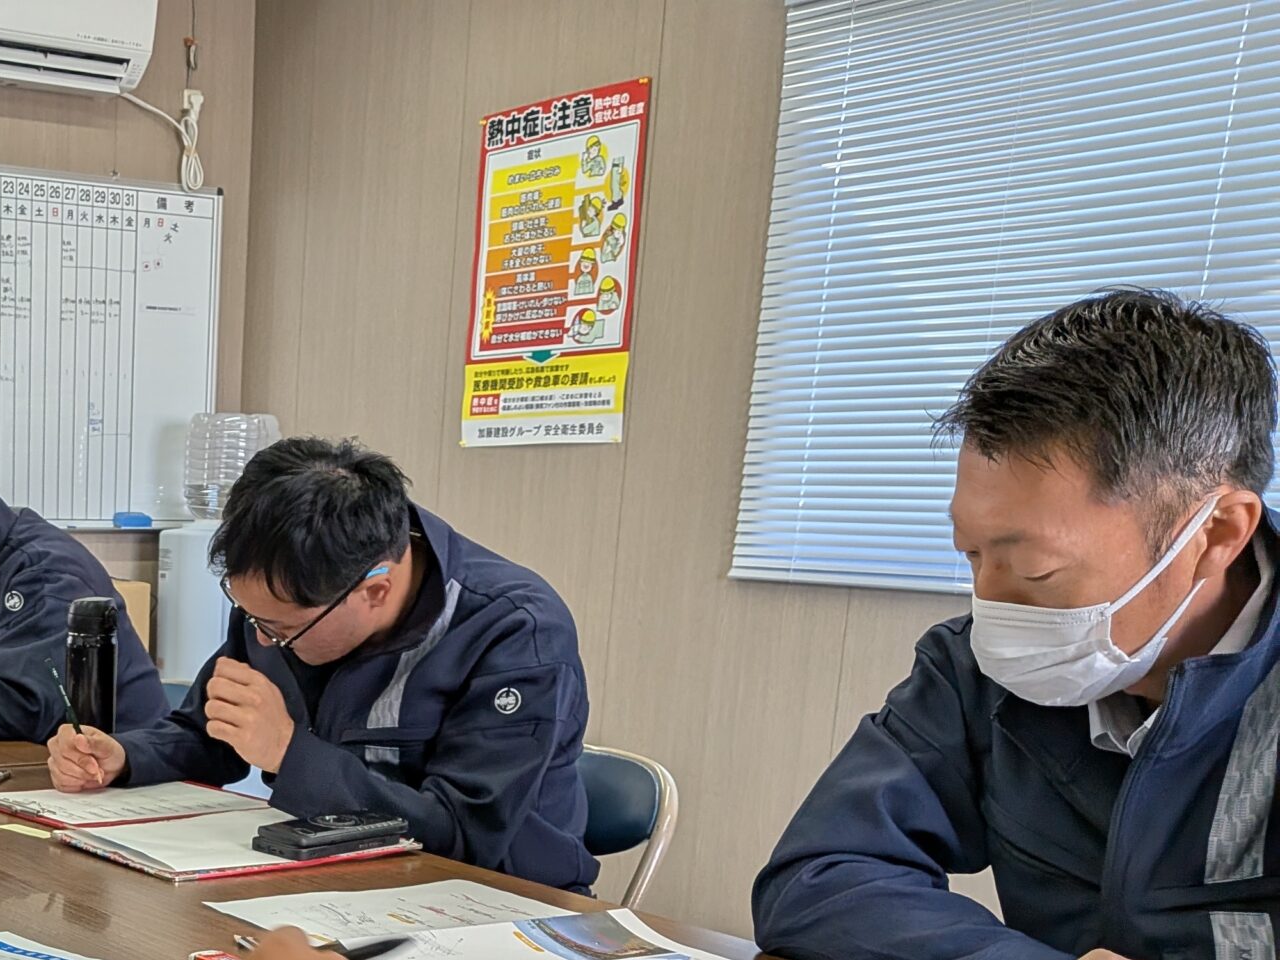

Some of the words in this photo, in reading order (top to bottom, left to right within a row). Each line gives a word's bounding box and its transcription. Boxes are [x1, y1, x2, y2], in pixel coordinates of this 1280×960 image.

[486, 95, 593, 147] 熱中症に注意
[527, 148, 541, 160] 症状
[3, 180, 14, 194] 23
[18, 182, 30, 196] 24
[34, 184, 45, 197] 25
[50, 185, 61, 199] 26
[65, 187, 76, 201] 27
[80, 189, 91, 202] 28
[95, 190, 106, 204] 29
[110, 192, 121, 206] 30
[125, 193, 135, 207] 31
[3, 204, 13, 215] 木
[18, 204, 28, 216] 金
[34, 207, 44, 217] 土
[52, 207, 59, 217] 日
[67, 209, 75, 220] 月
[80, 211, 90, 222] 火
[95, 212, 105, 224] 水
[110, 213, 120, 225] 木
[125, 215, 135, 227] 金
[144, 218, 151, 228] 月
[157, 217, 165, 228] 日
[170, 222, 179, 233] 土
[163, 233, 173, 244] 火
[478, 425, 542, 439] 加藤建設グループ
[544, 422, 605, 436] 安全衛生委員会
